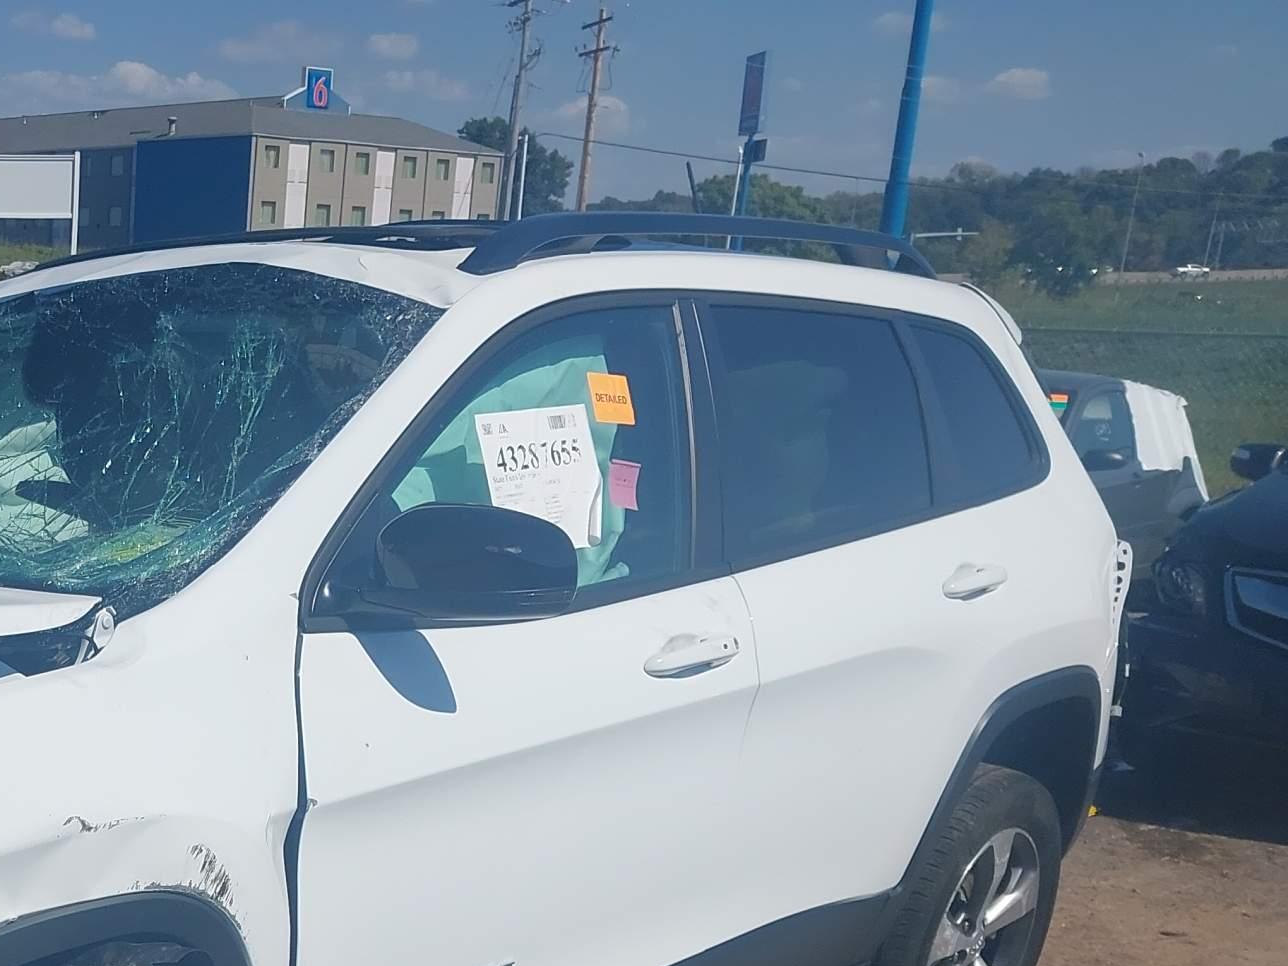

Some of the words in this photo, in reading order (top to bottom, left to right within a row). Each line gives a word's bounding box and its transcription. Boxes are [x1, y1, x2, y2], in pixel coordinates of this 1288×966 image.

[313, 76, 328, 107] 6
[595, 393, 628, 405] DETAILED
[496, 438, 582, 473] 43287655
